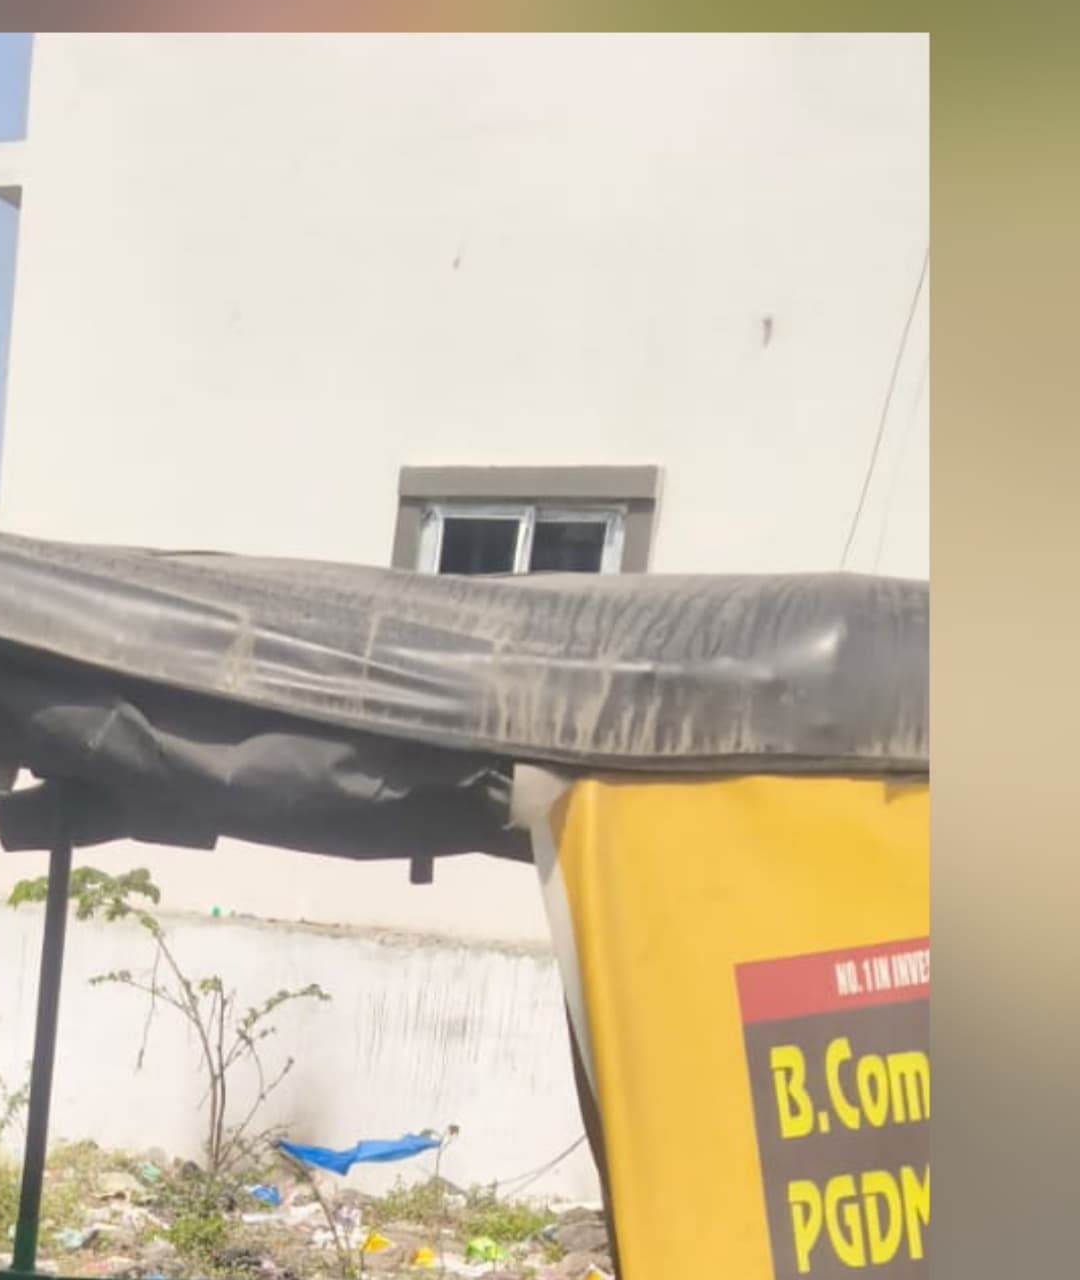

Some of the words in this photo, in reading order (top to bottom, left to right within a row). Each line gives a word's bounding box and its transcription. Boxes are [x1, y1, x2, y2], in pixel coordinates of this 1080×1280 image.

[834, 960, 863, 996] NO.
[862, 959, 873, 993] 1
[872, 956, 891, 991] IN
[771, 1036, 930, 1140] B.Com
